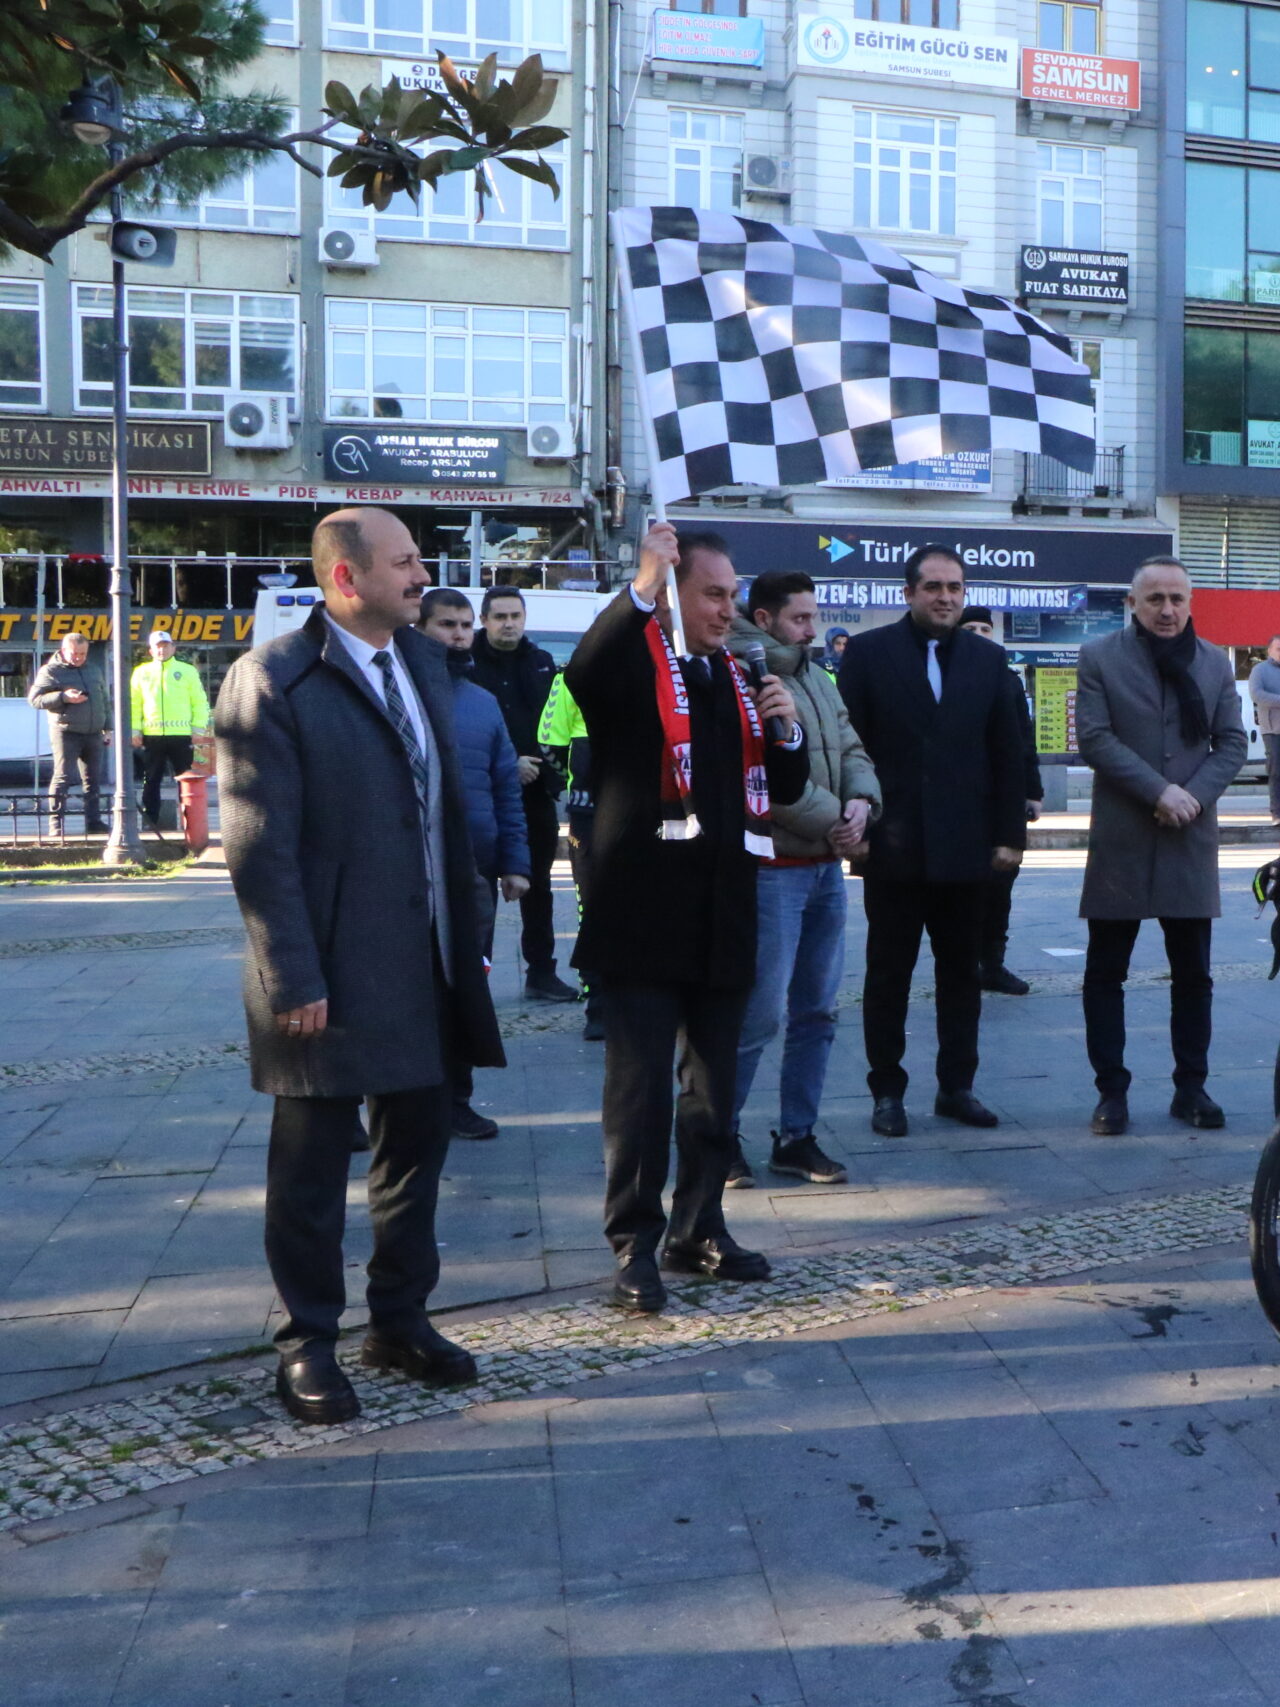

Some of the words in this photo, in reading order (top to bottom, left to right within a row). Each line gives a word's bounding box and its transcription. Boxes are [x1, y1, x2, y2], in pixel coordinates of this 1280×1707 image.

[854, 29, 916, 53] EĞİTİM
[920, 37, 969, 59] GÜCÜ
[973, 45, 1008, 63] SEN
[887, 64, 921, 75] SAMSUN
[1034, 52, 1103, 70] SEVDAMIZ
[1032, 64, 1129, 93] SAMSUN
[1032, 86, 1073, 100] GENEL
[1075, 90, 1128, 105] MERKEZİ
[1048, 251, 1079, 264] SARIKAYA
[1080, 253, 1102, 265] HUKUK
[1060, 268, 1118, 282] AVUKAT
[1025, 280, 1059, 294] FUAT
[1062, 283, 1127, 299] SARIKAYA
[0, 427, 58, 445] ETAL
[67, 429, 195, 449] SENİKASI
[1249, 439, 1275, 449] AVUKAT
[381, 447, 421, 457] AVUKAT
[430, 449, 489, 459] ARABULUCU
[400, 458, 429, 468] Recep
[431, 459, 470, 468] ARSLAN
[0, 479, 81, 494] AHVALTI
[127, 479, 170, 496] NIT
[174, 480, 251, 498] TERME
[346, 487, 404, 502] KEBAP
[539, 491, 572, 504] 7/24
[859, 540, 919, 563] Türk
[1009, 587, 1070, 609] NOKTASI
[820, 609, 861, 625] tivibu
[234, 614, 256, 641] V
